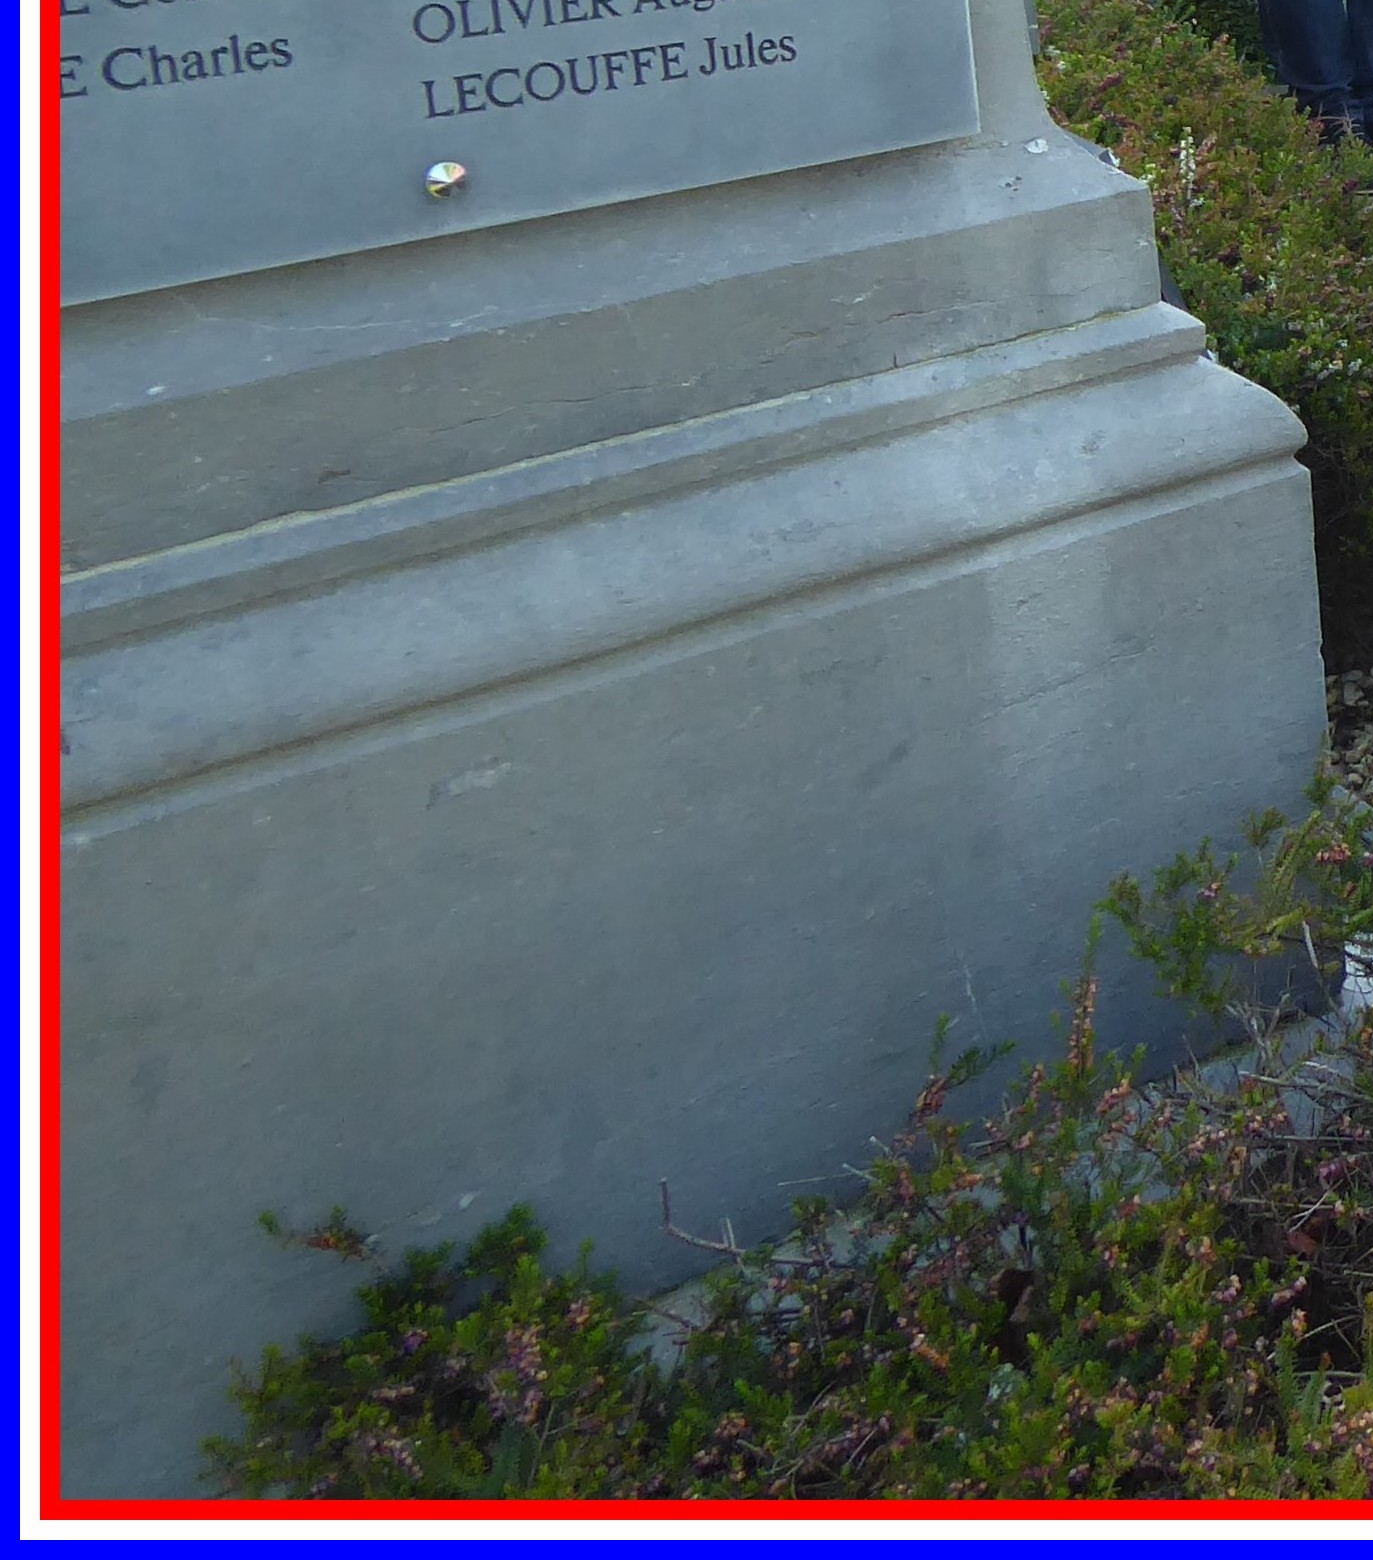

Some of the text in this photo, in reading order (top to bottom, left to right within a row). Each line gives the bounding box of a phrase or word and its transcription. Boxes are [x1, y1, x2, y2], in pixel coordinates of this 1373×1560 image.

[102, 34, 293, 90] Charles
[422, 32, 797, 119] LECOUFFE Jules
